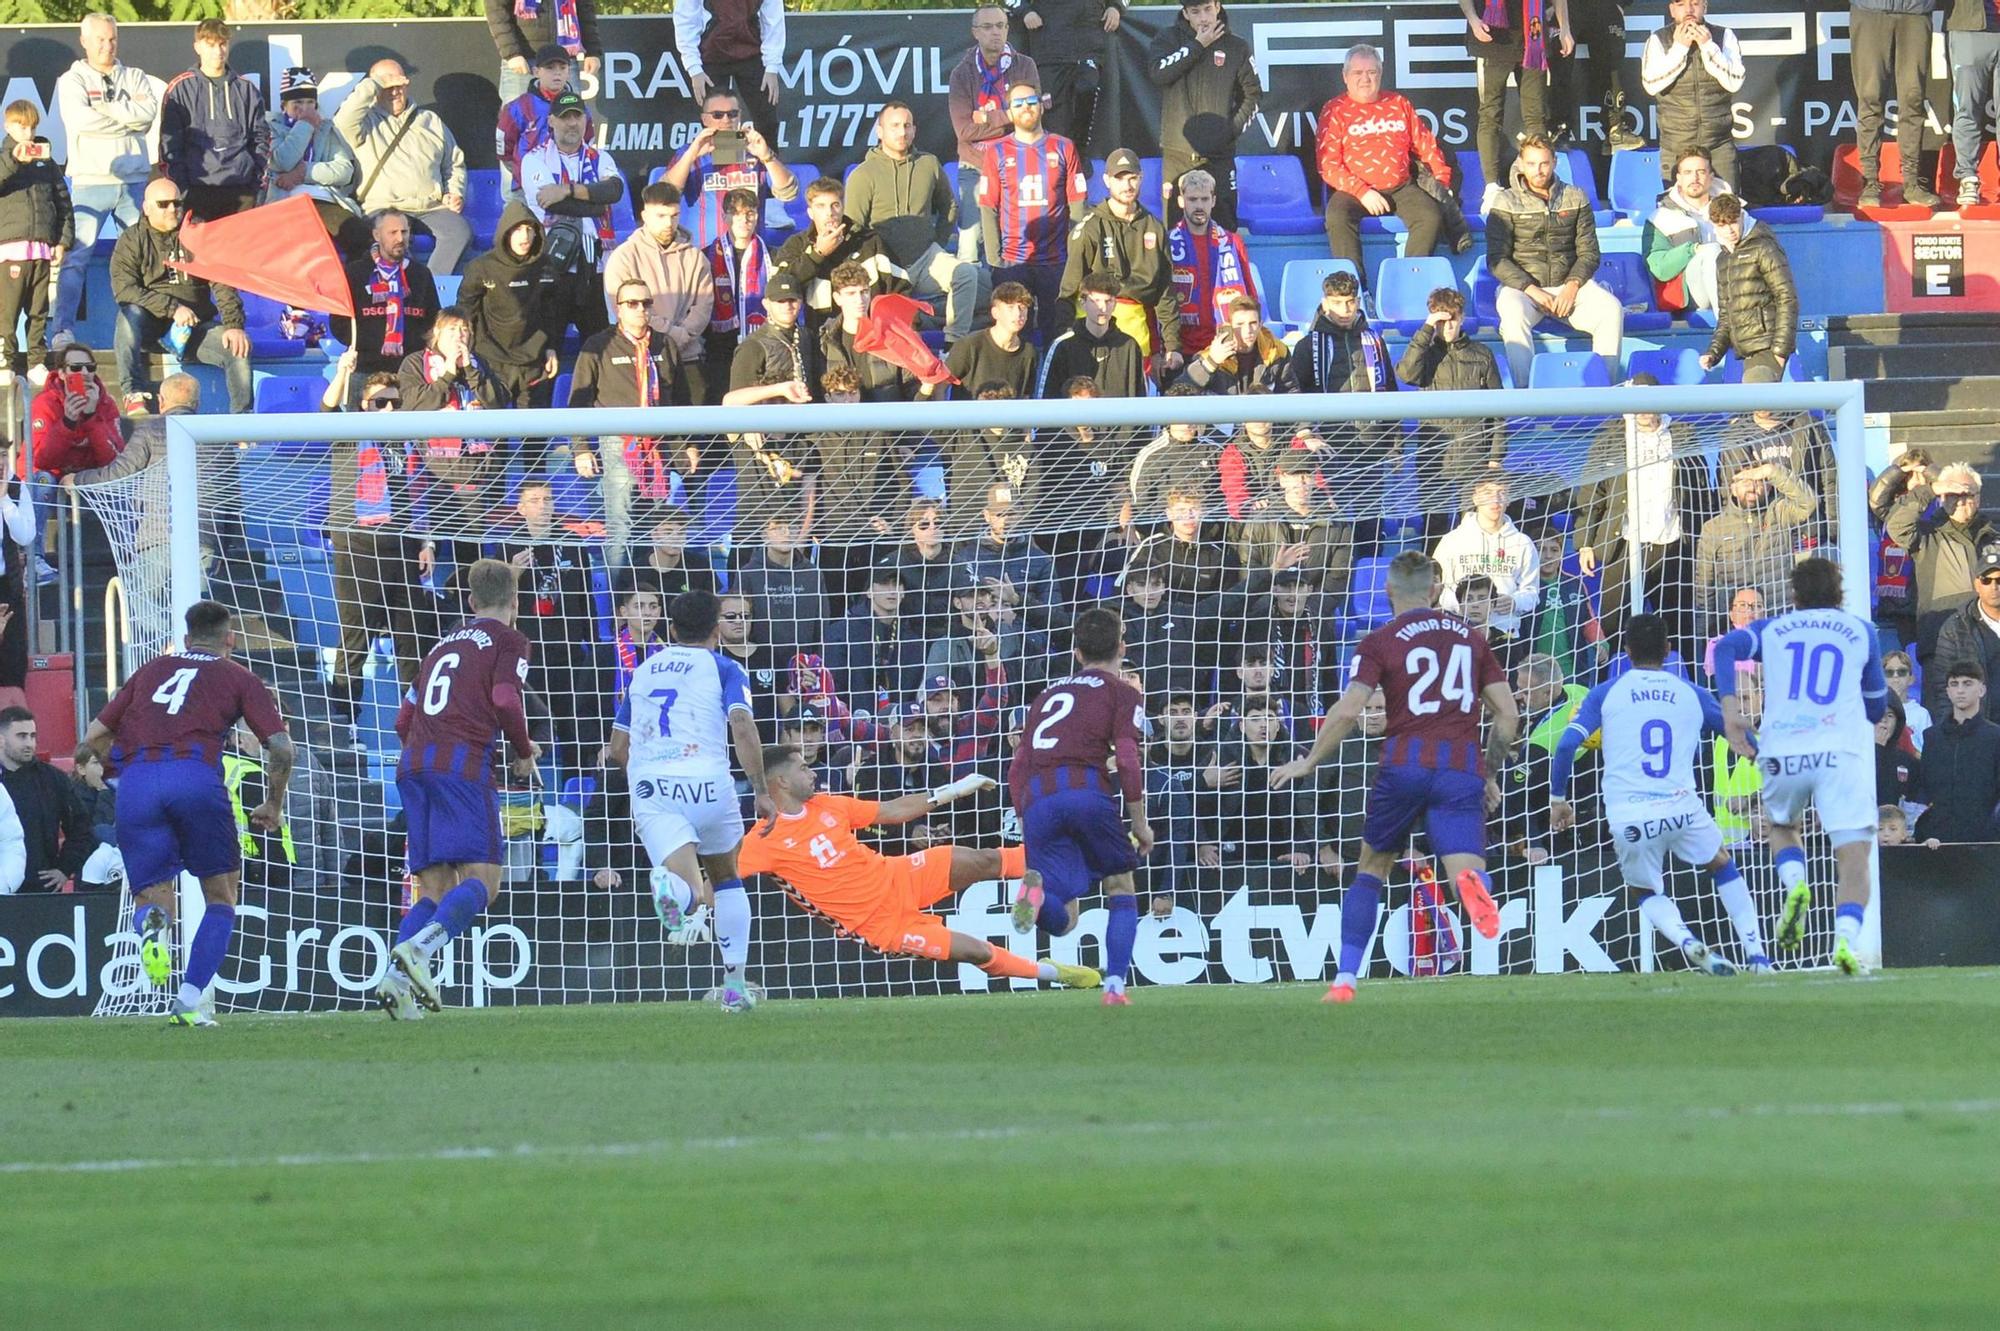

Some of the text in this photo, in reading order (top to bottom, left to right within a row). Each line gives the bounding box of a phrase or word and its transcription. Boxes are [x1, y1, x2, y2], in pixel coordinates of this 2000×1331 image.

[1348, 116, 1406, 137] adidas
[704, 172, 757, 189] BigMat
[1914, 246, 1962, 260] SECTOR
[1938, 236, 1962, 246] NORTE
[1926, 264, 1951, 295] E
[1462, 564, 1514, 574] THAN SORRY
[1773, 618, 1862, 645] ALEXANDRE
[650, 661, 695, 675] ELADY
[1406, 644, 1474, 716] 24
[1784, 641, 1844, 706] 10
[152, 667, 199, 715] 4
[423, 652, 460, 716] 6
[1631, 688, 1677, 705] ÁNGEL
[648, 688, 678, 738] 7
[1032, 692, 1075, 750] 2
[1641, 719, 1673, 779] 9
[1785, 752, 1838, 776] EAVE
[656, 778, 718, 804] EAVE
[1643, 813, 1697, 840] EAVE
